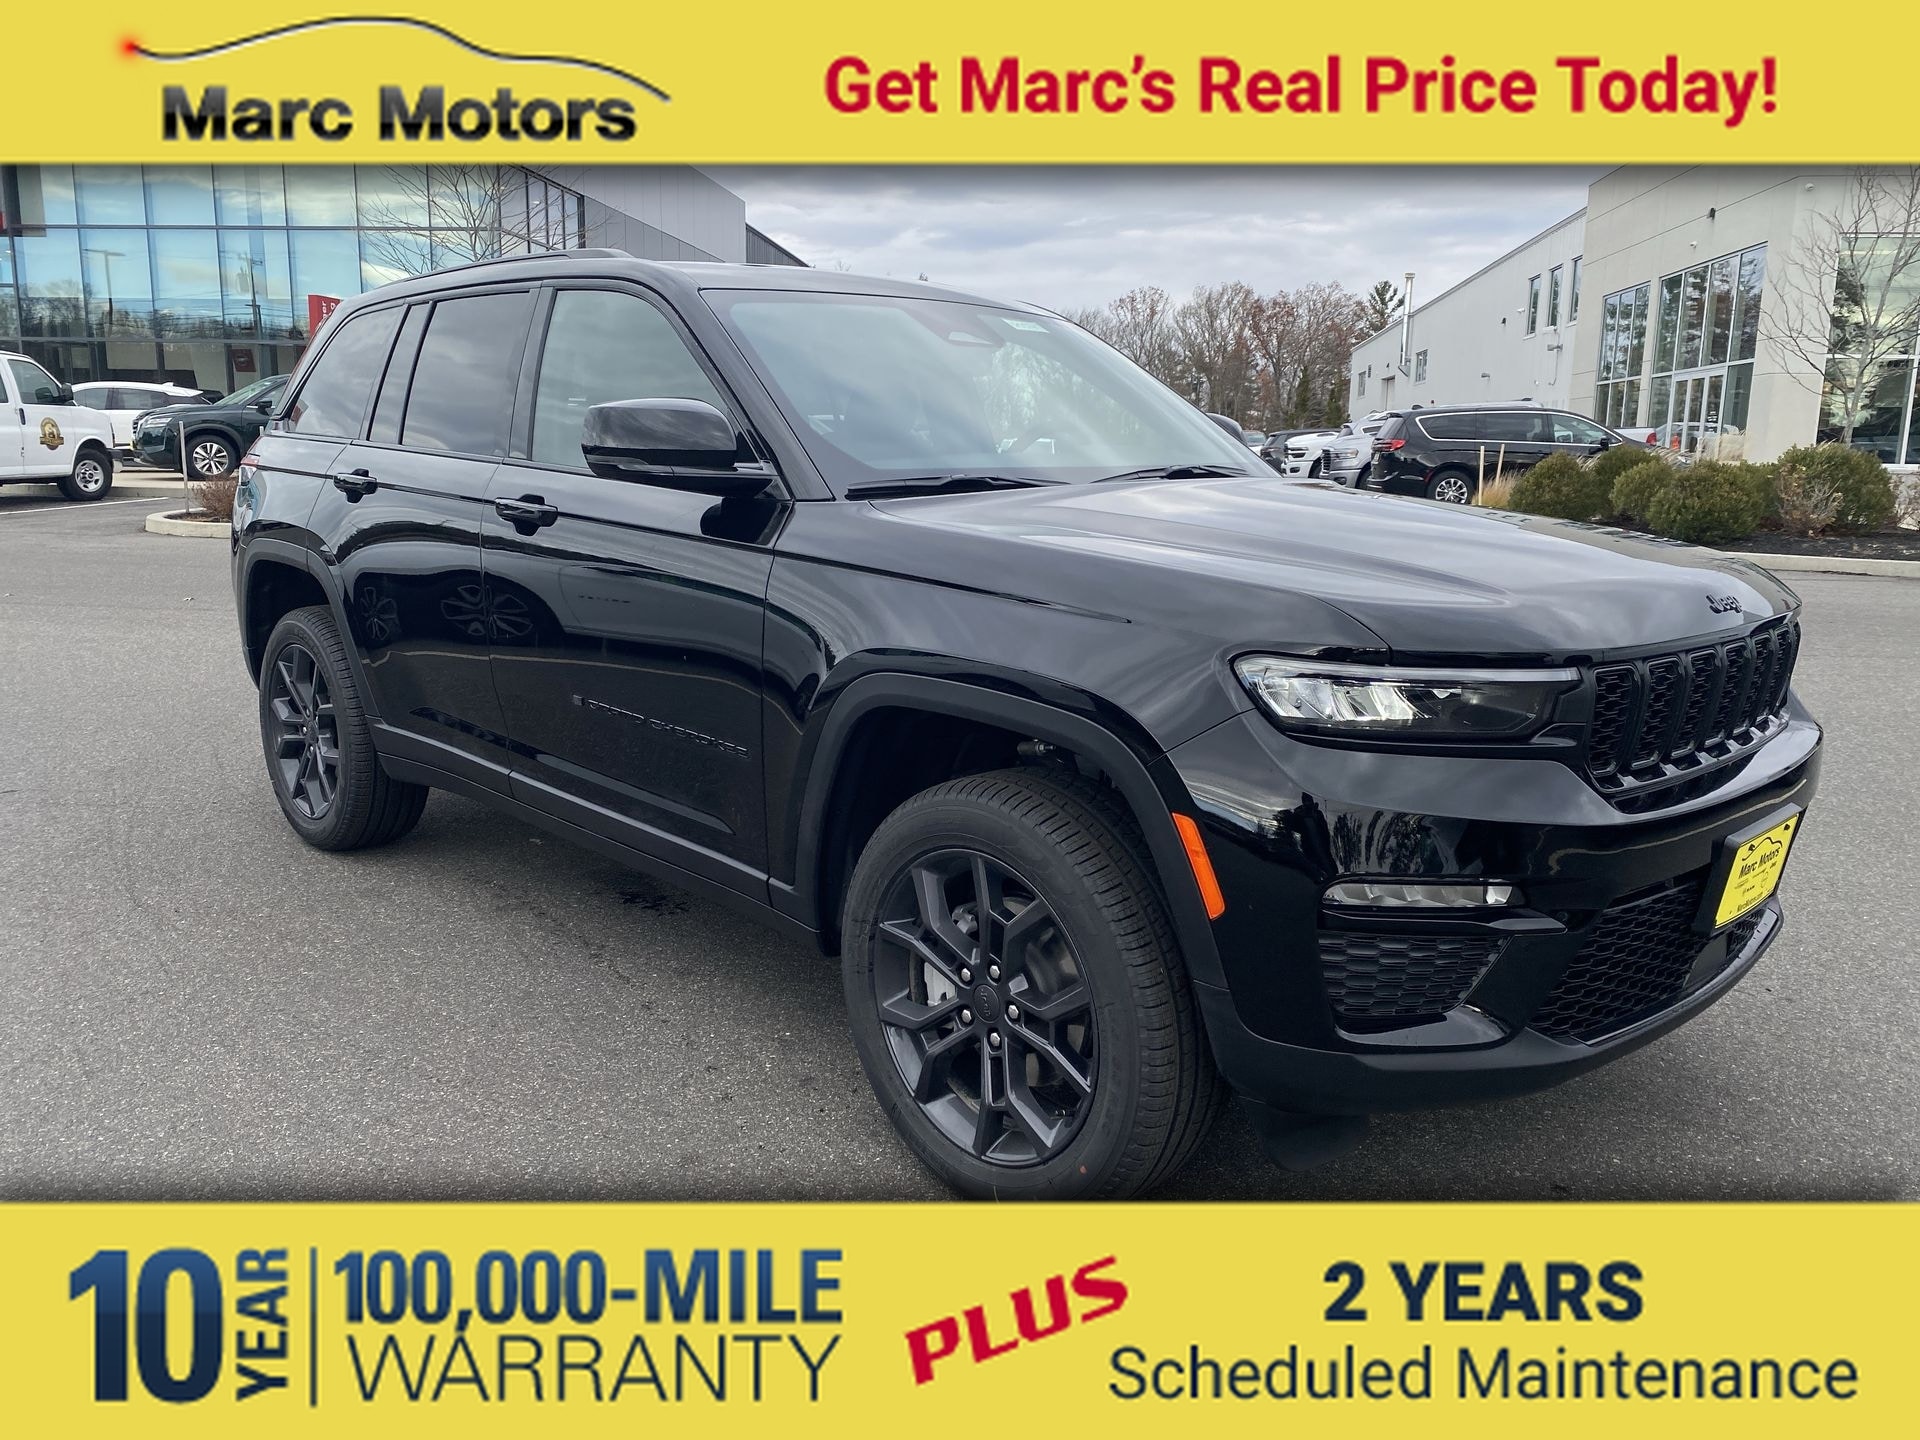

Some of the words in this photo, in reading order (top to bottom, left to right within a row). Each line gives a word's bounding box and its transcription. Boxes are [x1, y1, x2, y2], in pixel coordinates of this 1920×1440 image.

[1706, 594, 1743, 614] Jeep
[1738, 861, 1758, 879] Marc
[1757, 846, 1780, 869] Motors
